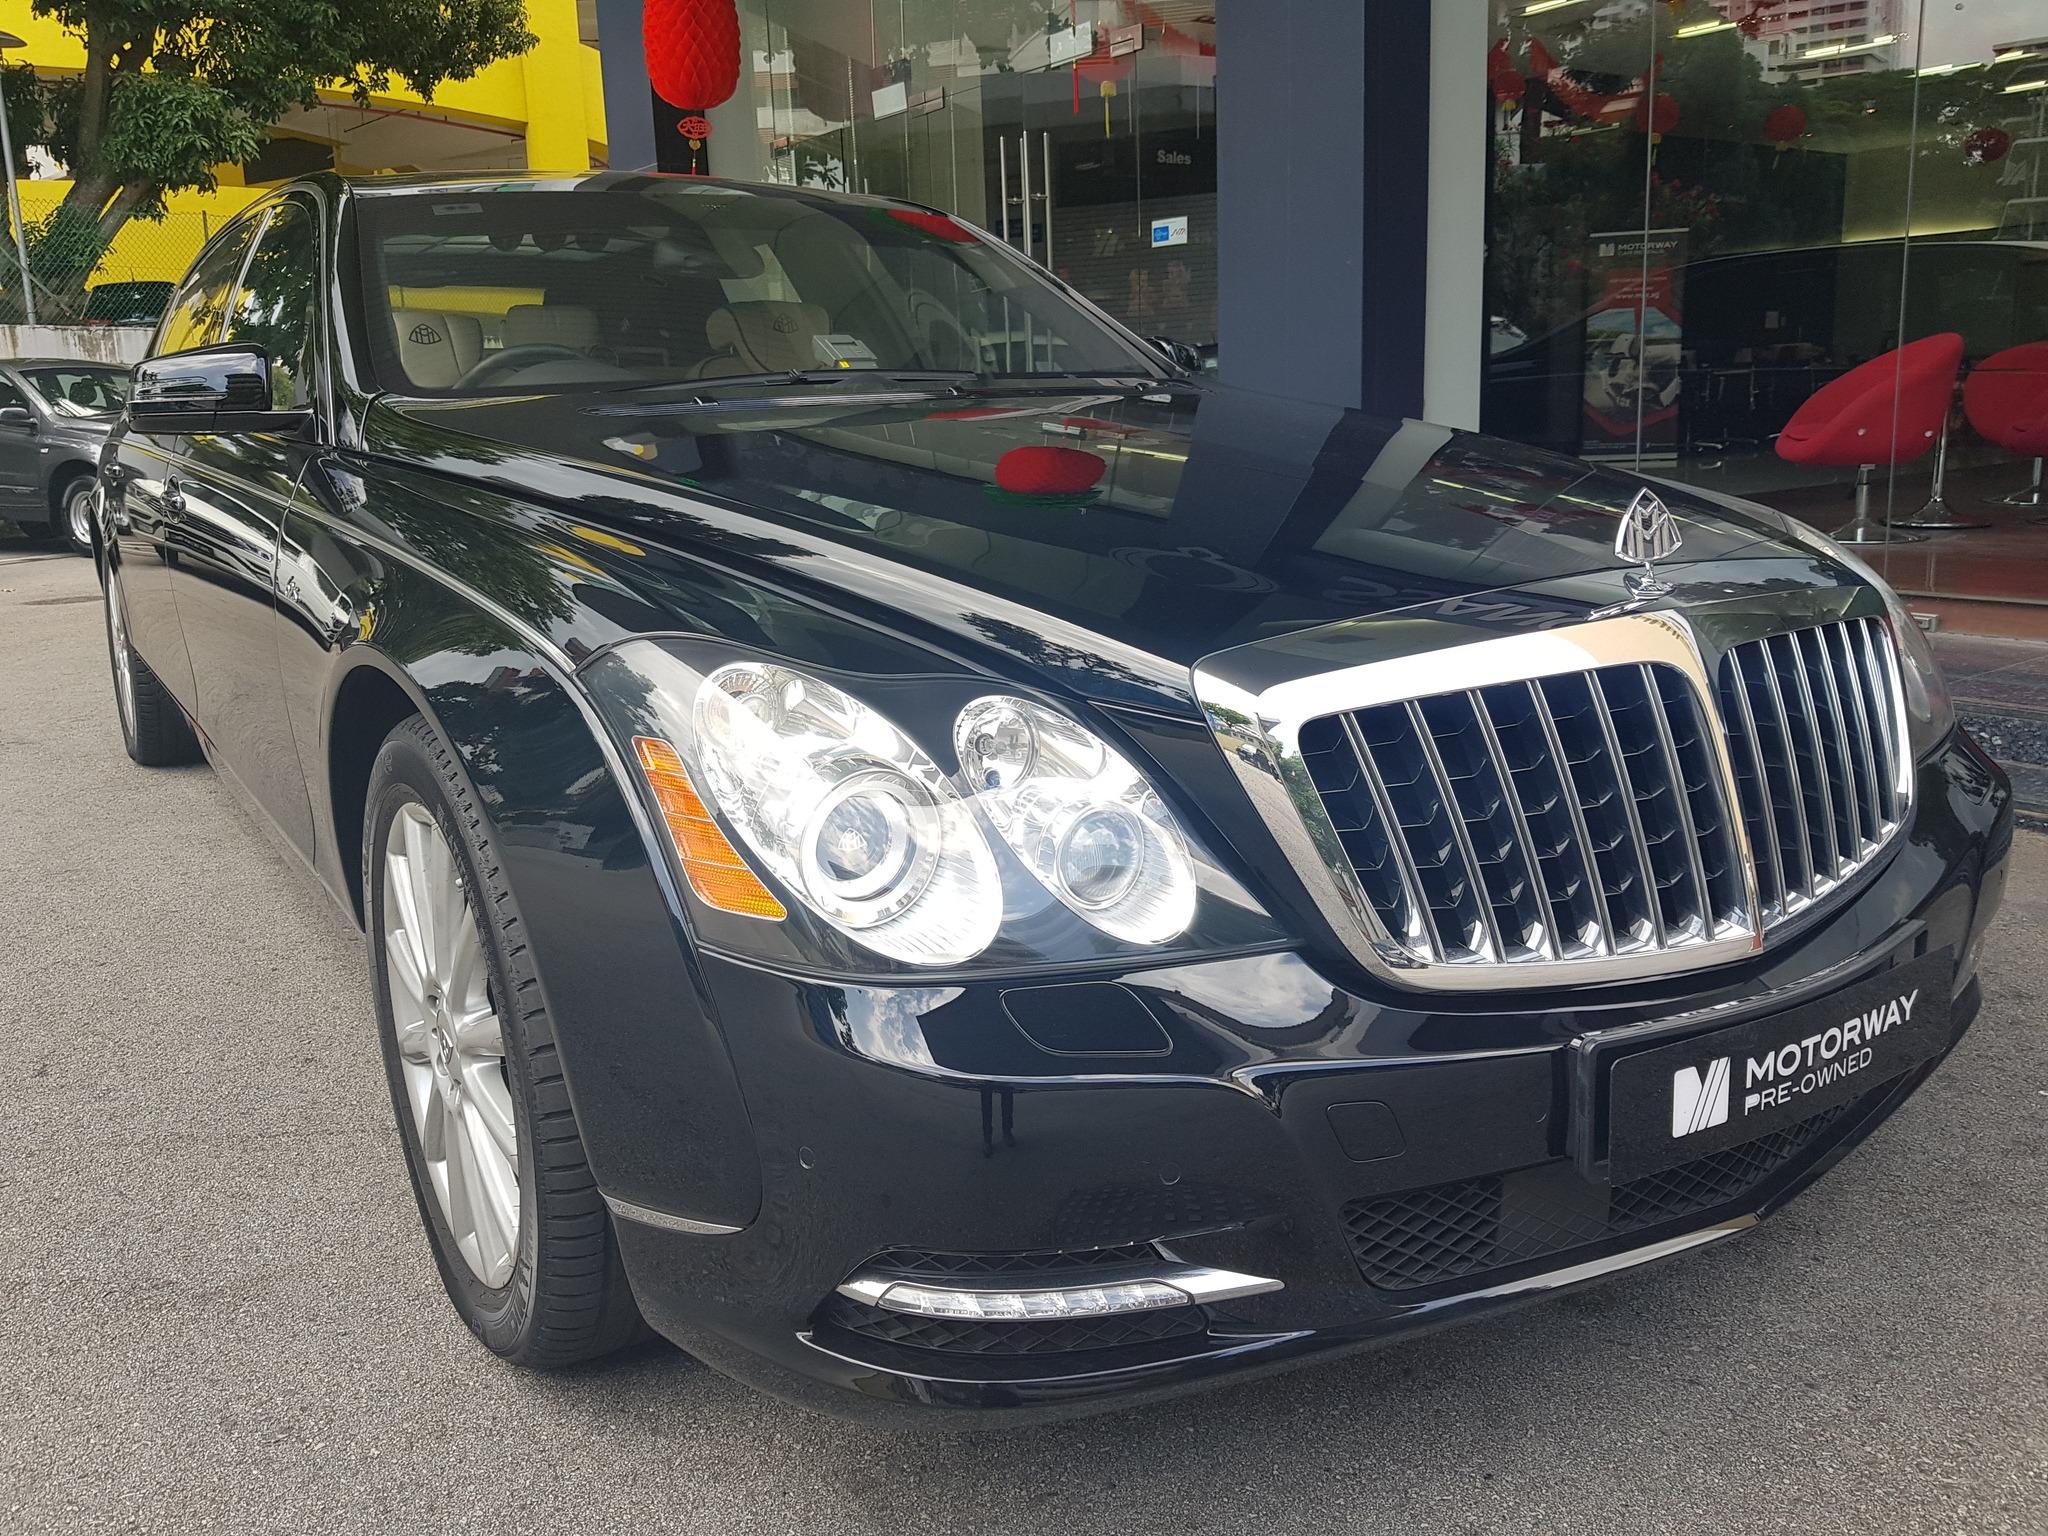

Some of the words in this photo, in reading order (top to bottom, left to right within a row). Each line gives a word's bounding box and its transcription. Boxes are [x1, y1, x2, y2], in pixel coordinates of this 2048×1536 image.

[1157, 149, 1192, 164] Sales
[1617, 241, 1677, 250] MOTORWAY
[1746, 989, 1918, 1088] MOTORWAY
[1744, 1047, 1873, 1116] PRE-OWNED
